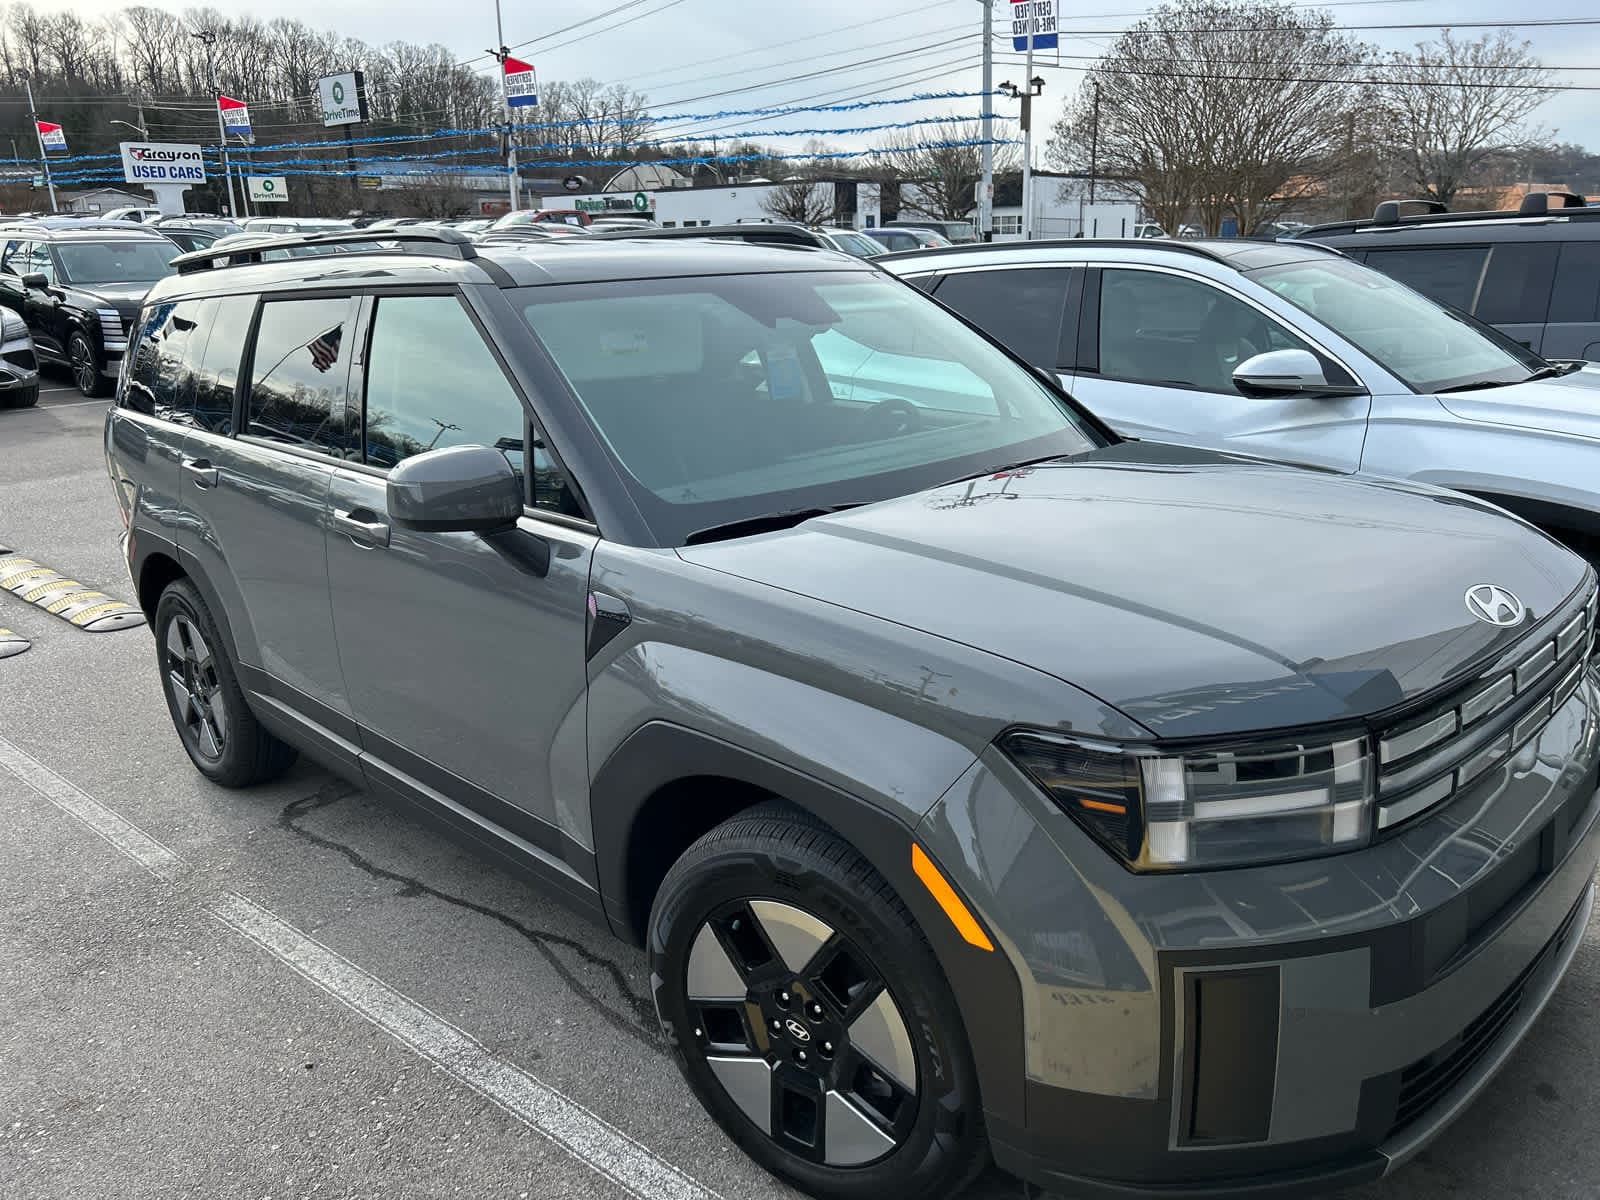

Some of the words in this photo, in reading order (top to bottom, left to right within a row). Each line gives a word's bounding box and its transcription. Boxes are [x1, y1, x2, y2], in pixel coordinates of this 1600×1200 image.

[323, 107, 360, 121] DriveTime
[142, 148, 201, 162] Grayson
[132, 165, 167, 178] USED
[169, 166, 203, 179] CARS
